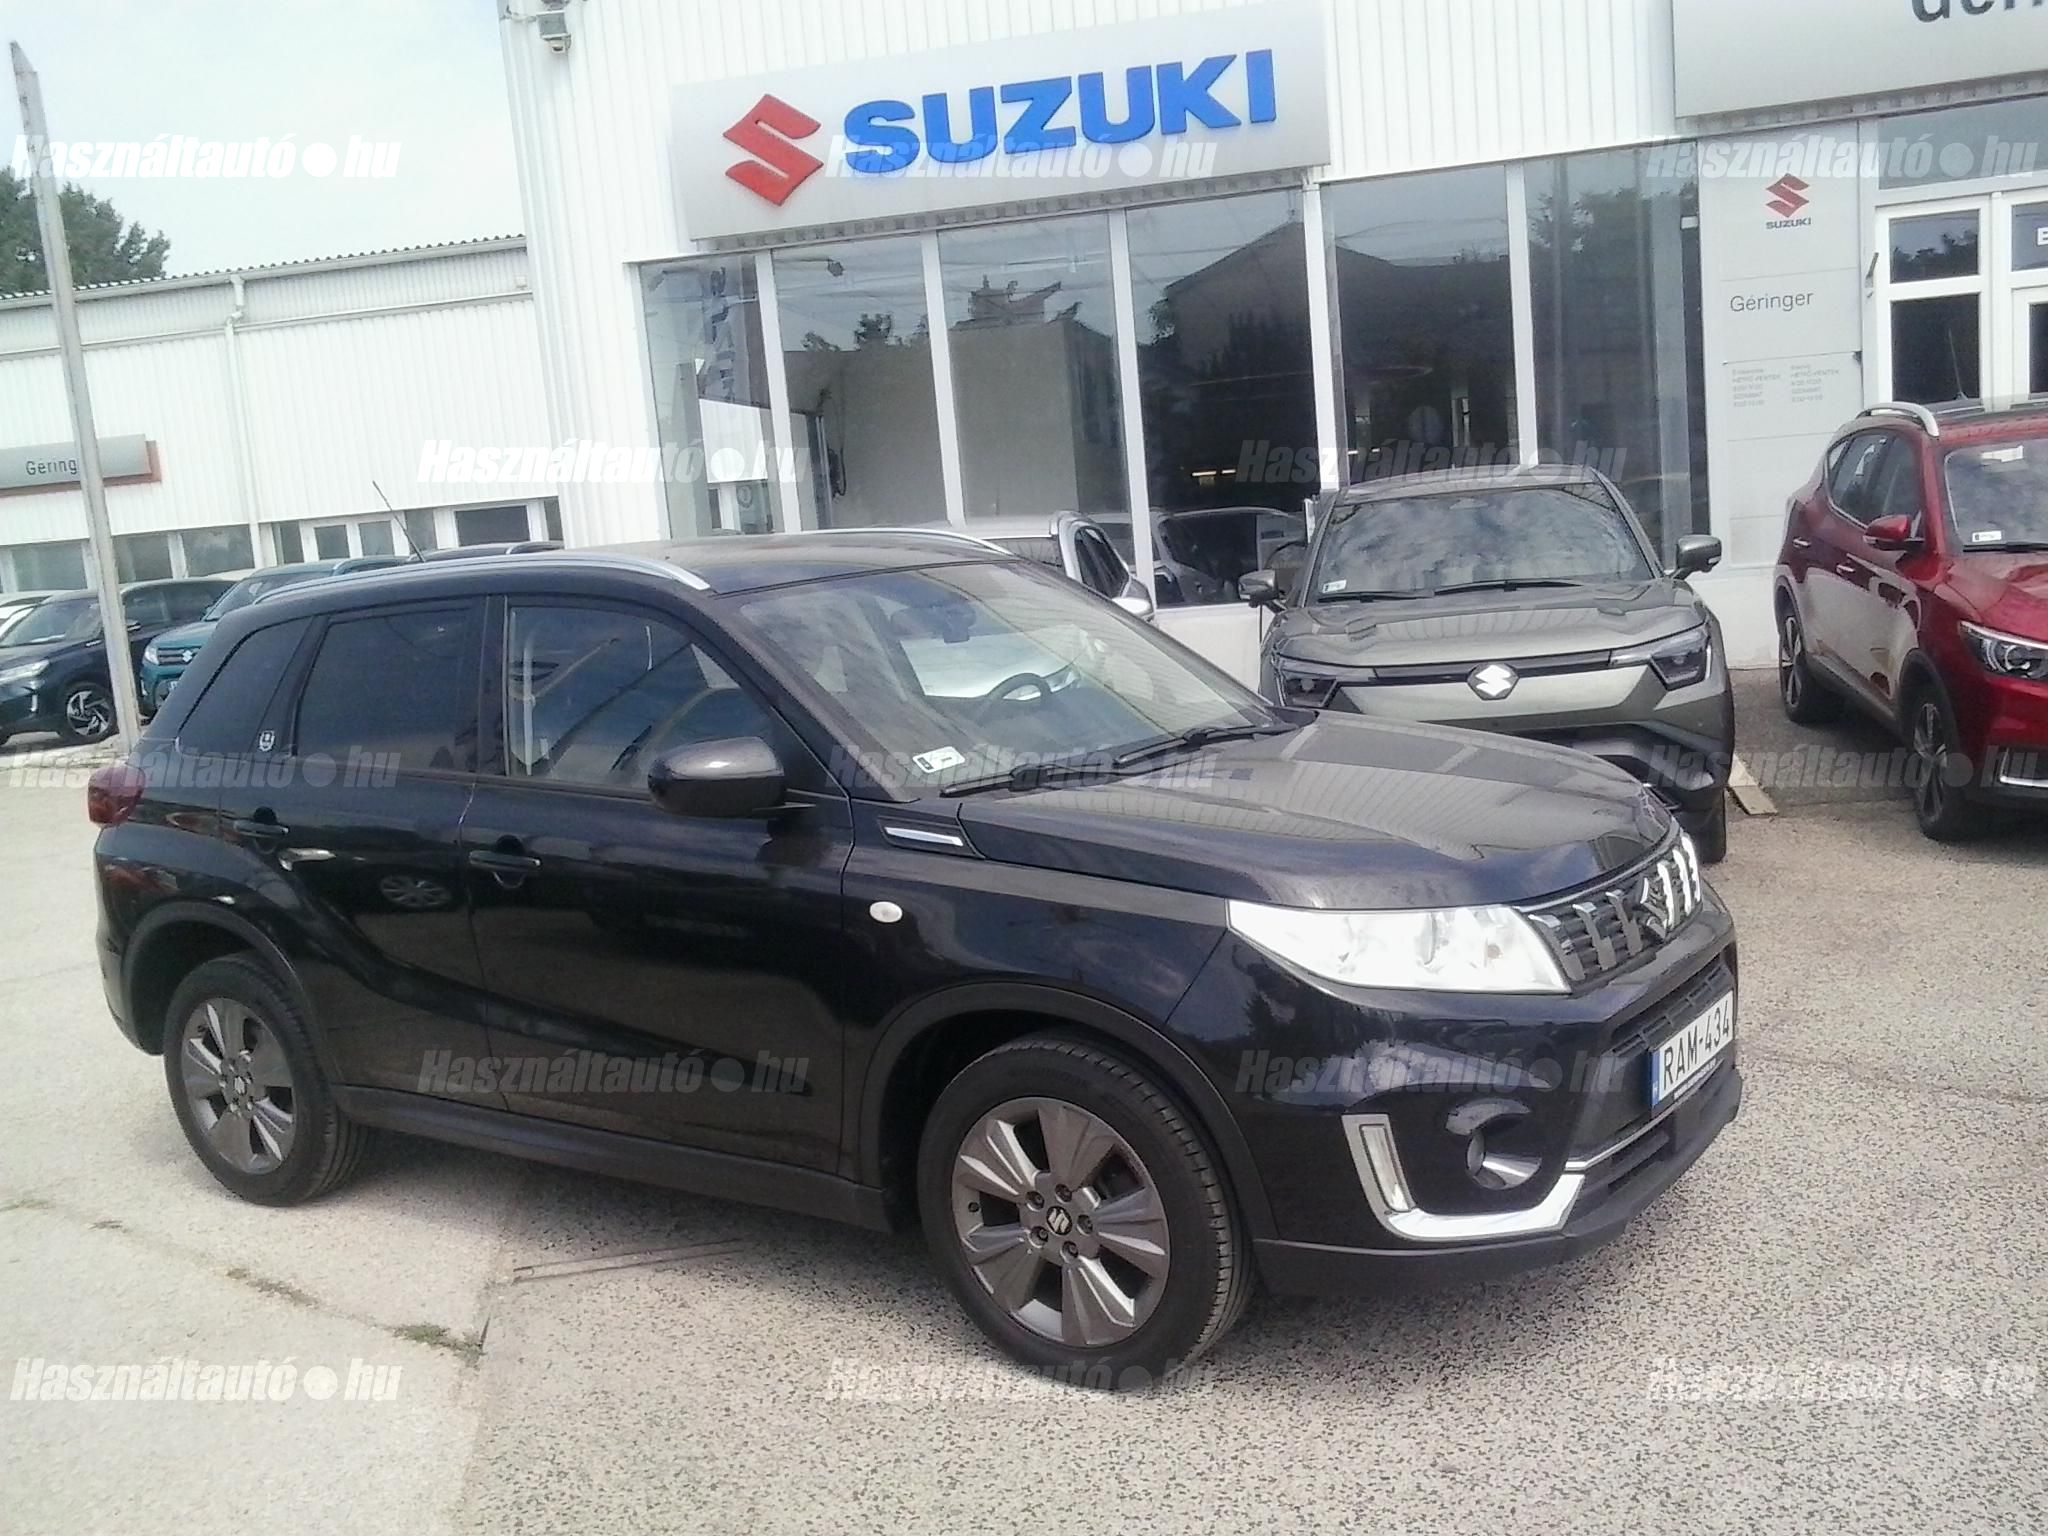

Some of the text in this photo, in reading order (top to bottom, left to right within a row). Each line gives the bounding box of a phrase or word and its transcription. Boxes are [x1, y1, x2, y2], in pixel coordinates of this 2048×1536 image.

[843, 49, 1277, 174] SUZUKI
[1765, 217, 1812, 230] SUZUKI
[1730, 291, 1814, 312] Géringer
[1662, 1000, 1730, 1091] RAM-434
